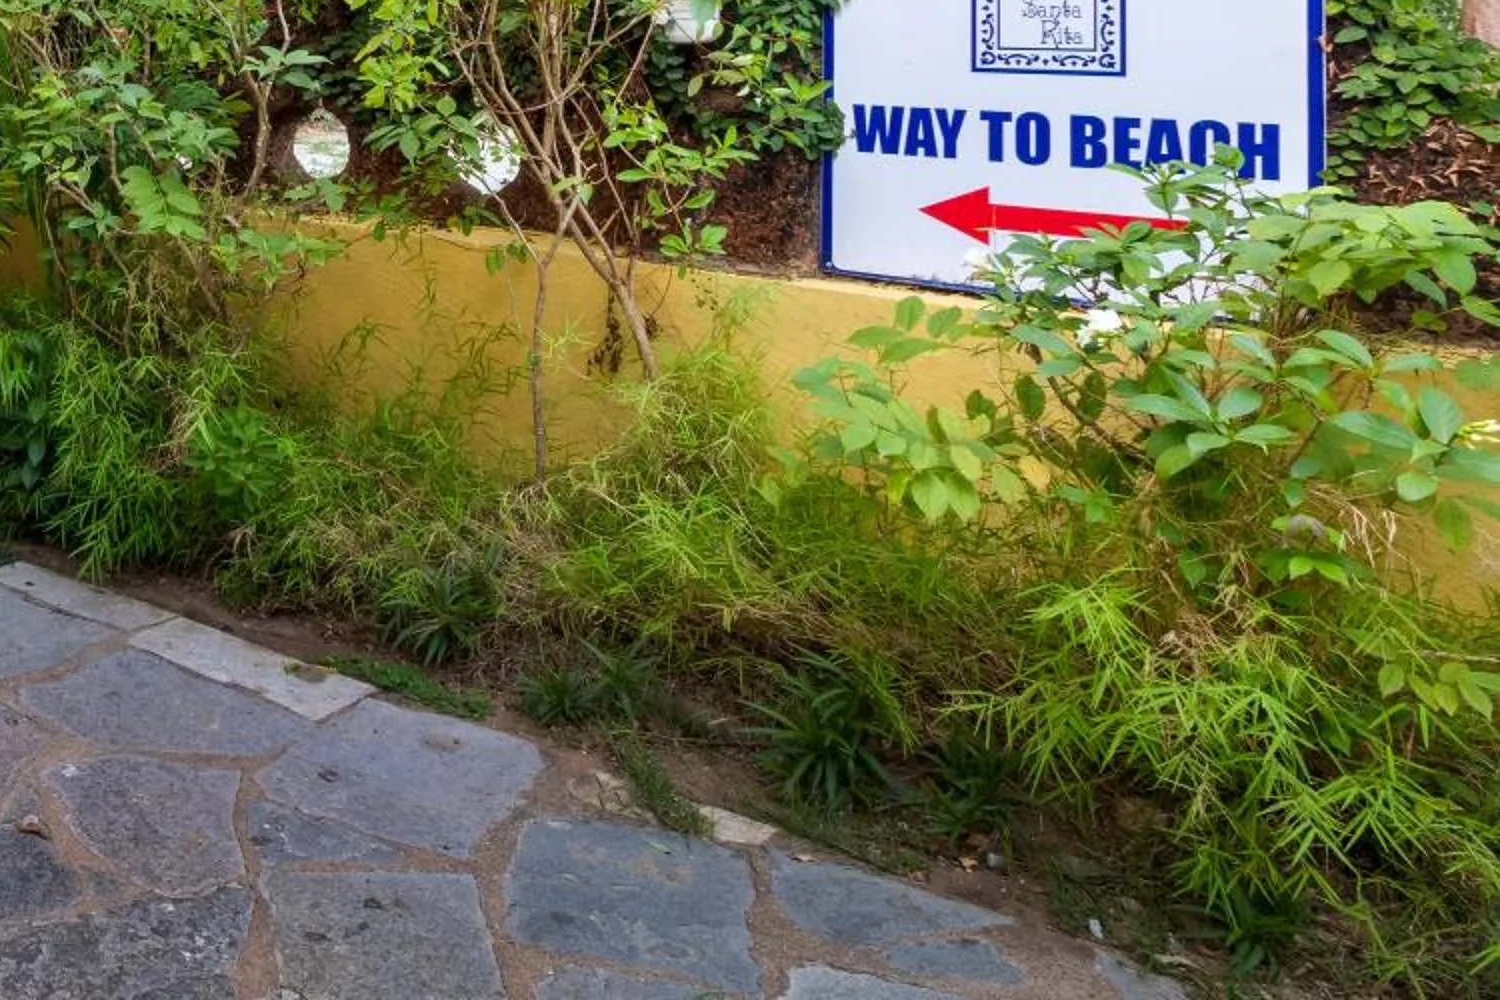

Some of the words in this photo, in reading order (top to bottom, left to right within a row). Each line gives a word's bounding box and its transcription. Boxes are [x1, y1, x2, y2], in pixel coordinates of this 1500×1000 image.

[1040, 18, 1084, 48] Rita
[852, 104, 967, 158] WAY
[980, 110, 1051, 165] TO
[1069, 115, 1280, 181] BEACH
